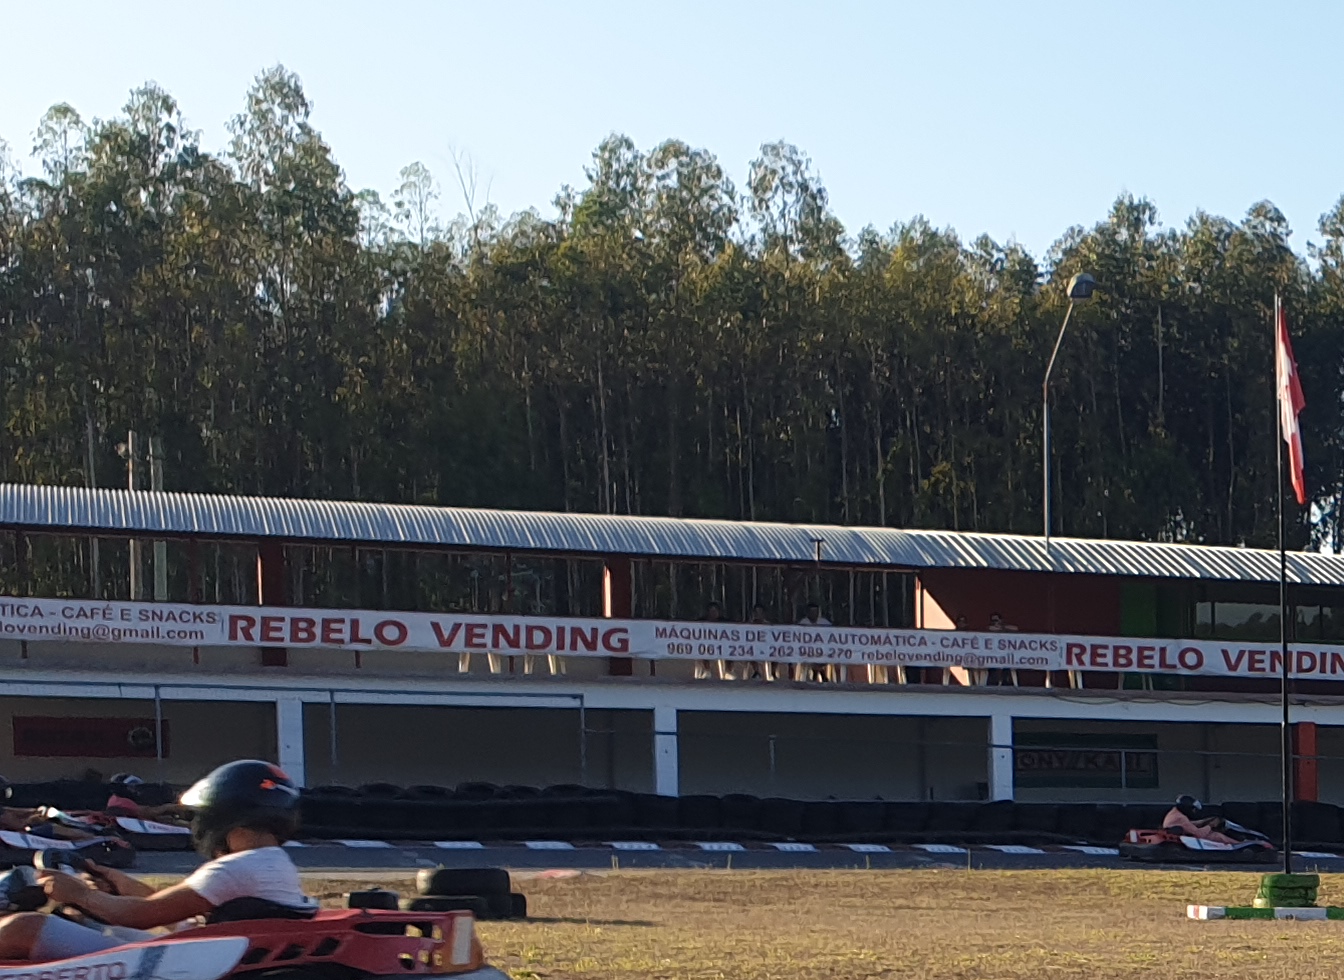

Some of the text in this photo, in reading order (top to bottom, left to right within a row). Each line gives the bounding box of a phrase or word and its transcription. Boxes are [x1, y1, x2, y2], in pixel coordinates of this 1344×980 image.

[62, 603, 113, 621] CAFÉ
[120, 608, 131, 622] E
[138, 608, 217, 624] SNACKS
[228, 614, 629, 653] REBELO VENDING
[655, 624, 740, 642] MÁQUINAS
[745, 630, 766, 642] DE
[771, 630, 823, 644] VENDA
[828, 632, 928, 647] AUTOMÁTICA
[941, 636, 979, 650] CAFÉ
[984, 637, 993, 650] E
[998, 638, 1058, 651] SNACKS
[667, 642, 693, 655] 969
[698, 643, 723, 656] 061
[729, 644, 754, 657] 234
[769, 645, 794, 658] 262
[800, 646, 824, 659] 989
[827, 647, 852, 659] 270
[861, 648, 1049, 667] rebelovending@gmail.com
[1066, 641, 1204, 670] REBELO
